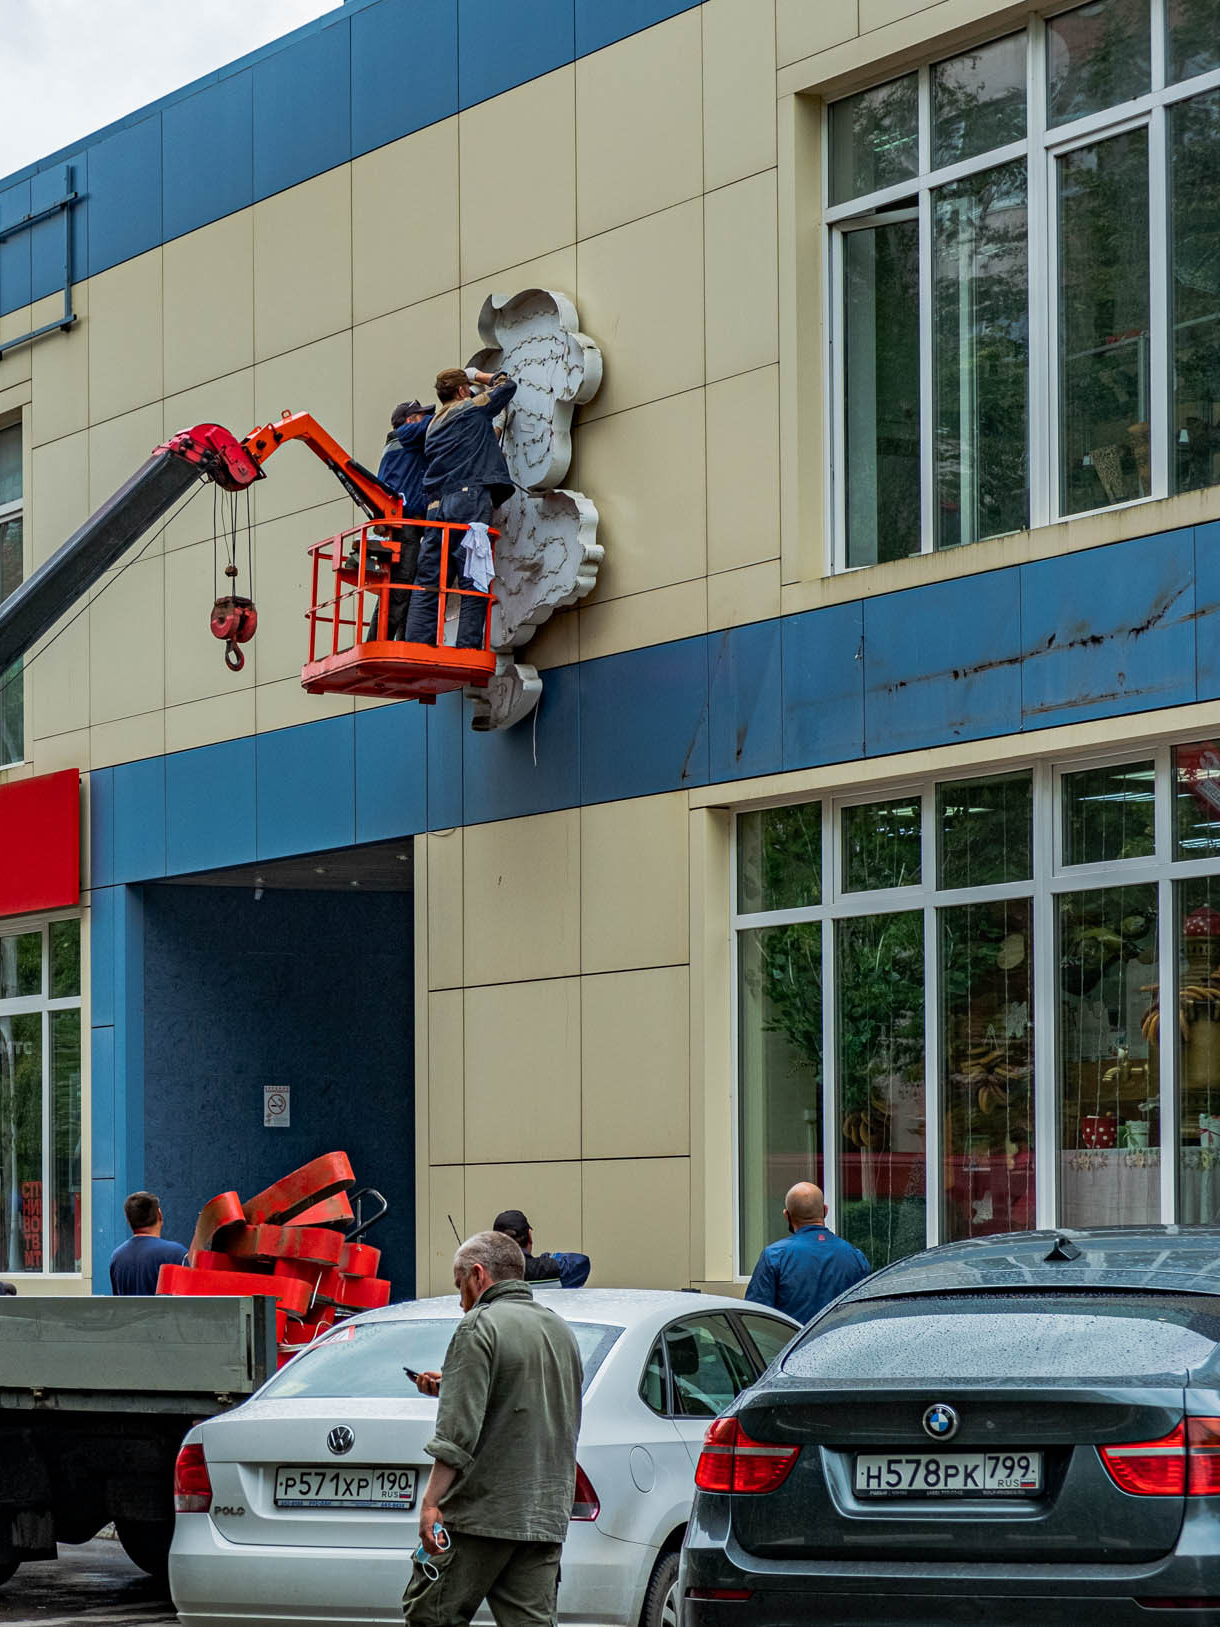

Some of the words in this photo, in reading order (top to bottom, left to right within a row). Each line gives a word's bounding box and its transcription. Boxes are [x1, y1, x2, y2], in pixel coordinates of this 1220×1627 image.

[22, 1181, 42, 1199] СП
[866, 1458, 980, 1488] Н578РК
[987, 1456, 1030, 1479] 799
[284, 1472, 370, 1496] Р571ХР
[376, 1472, 408, 1490] 190
[997, 1479, 1020, 1487] RUS
[382, 1490, 398, 1498] RUS
[214, 1506, 246, 1516] POLO
